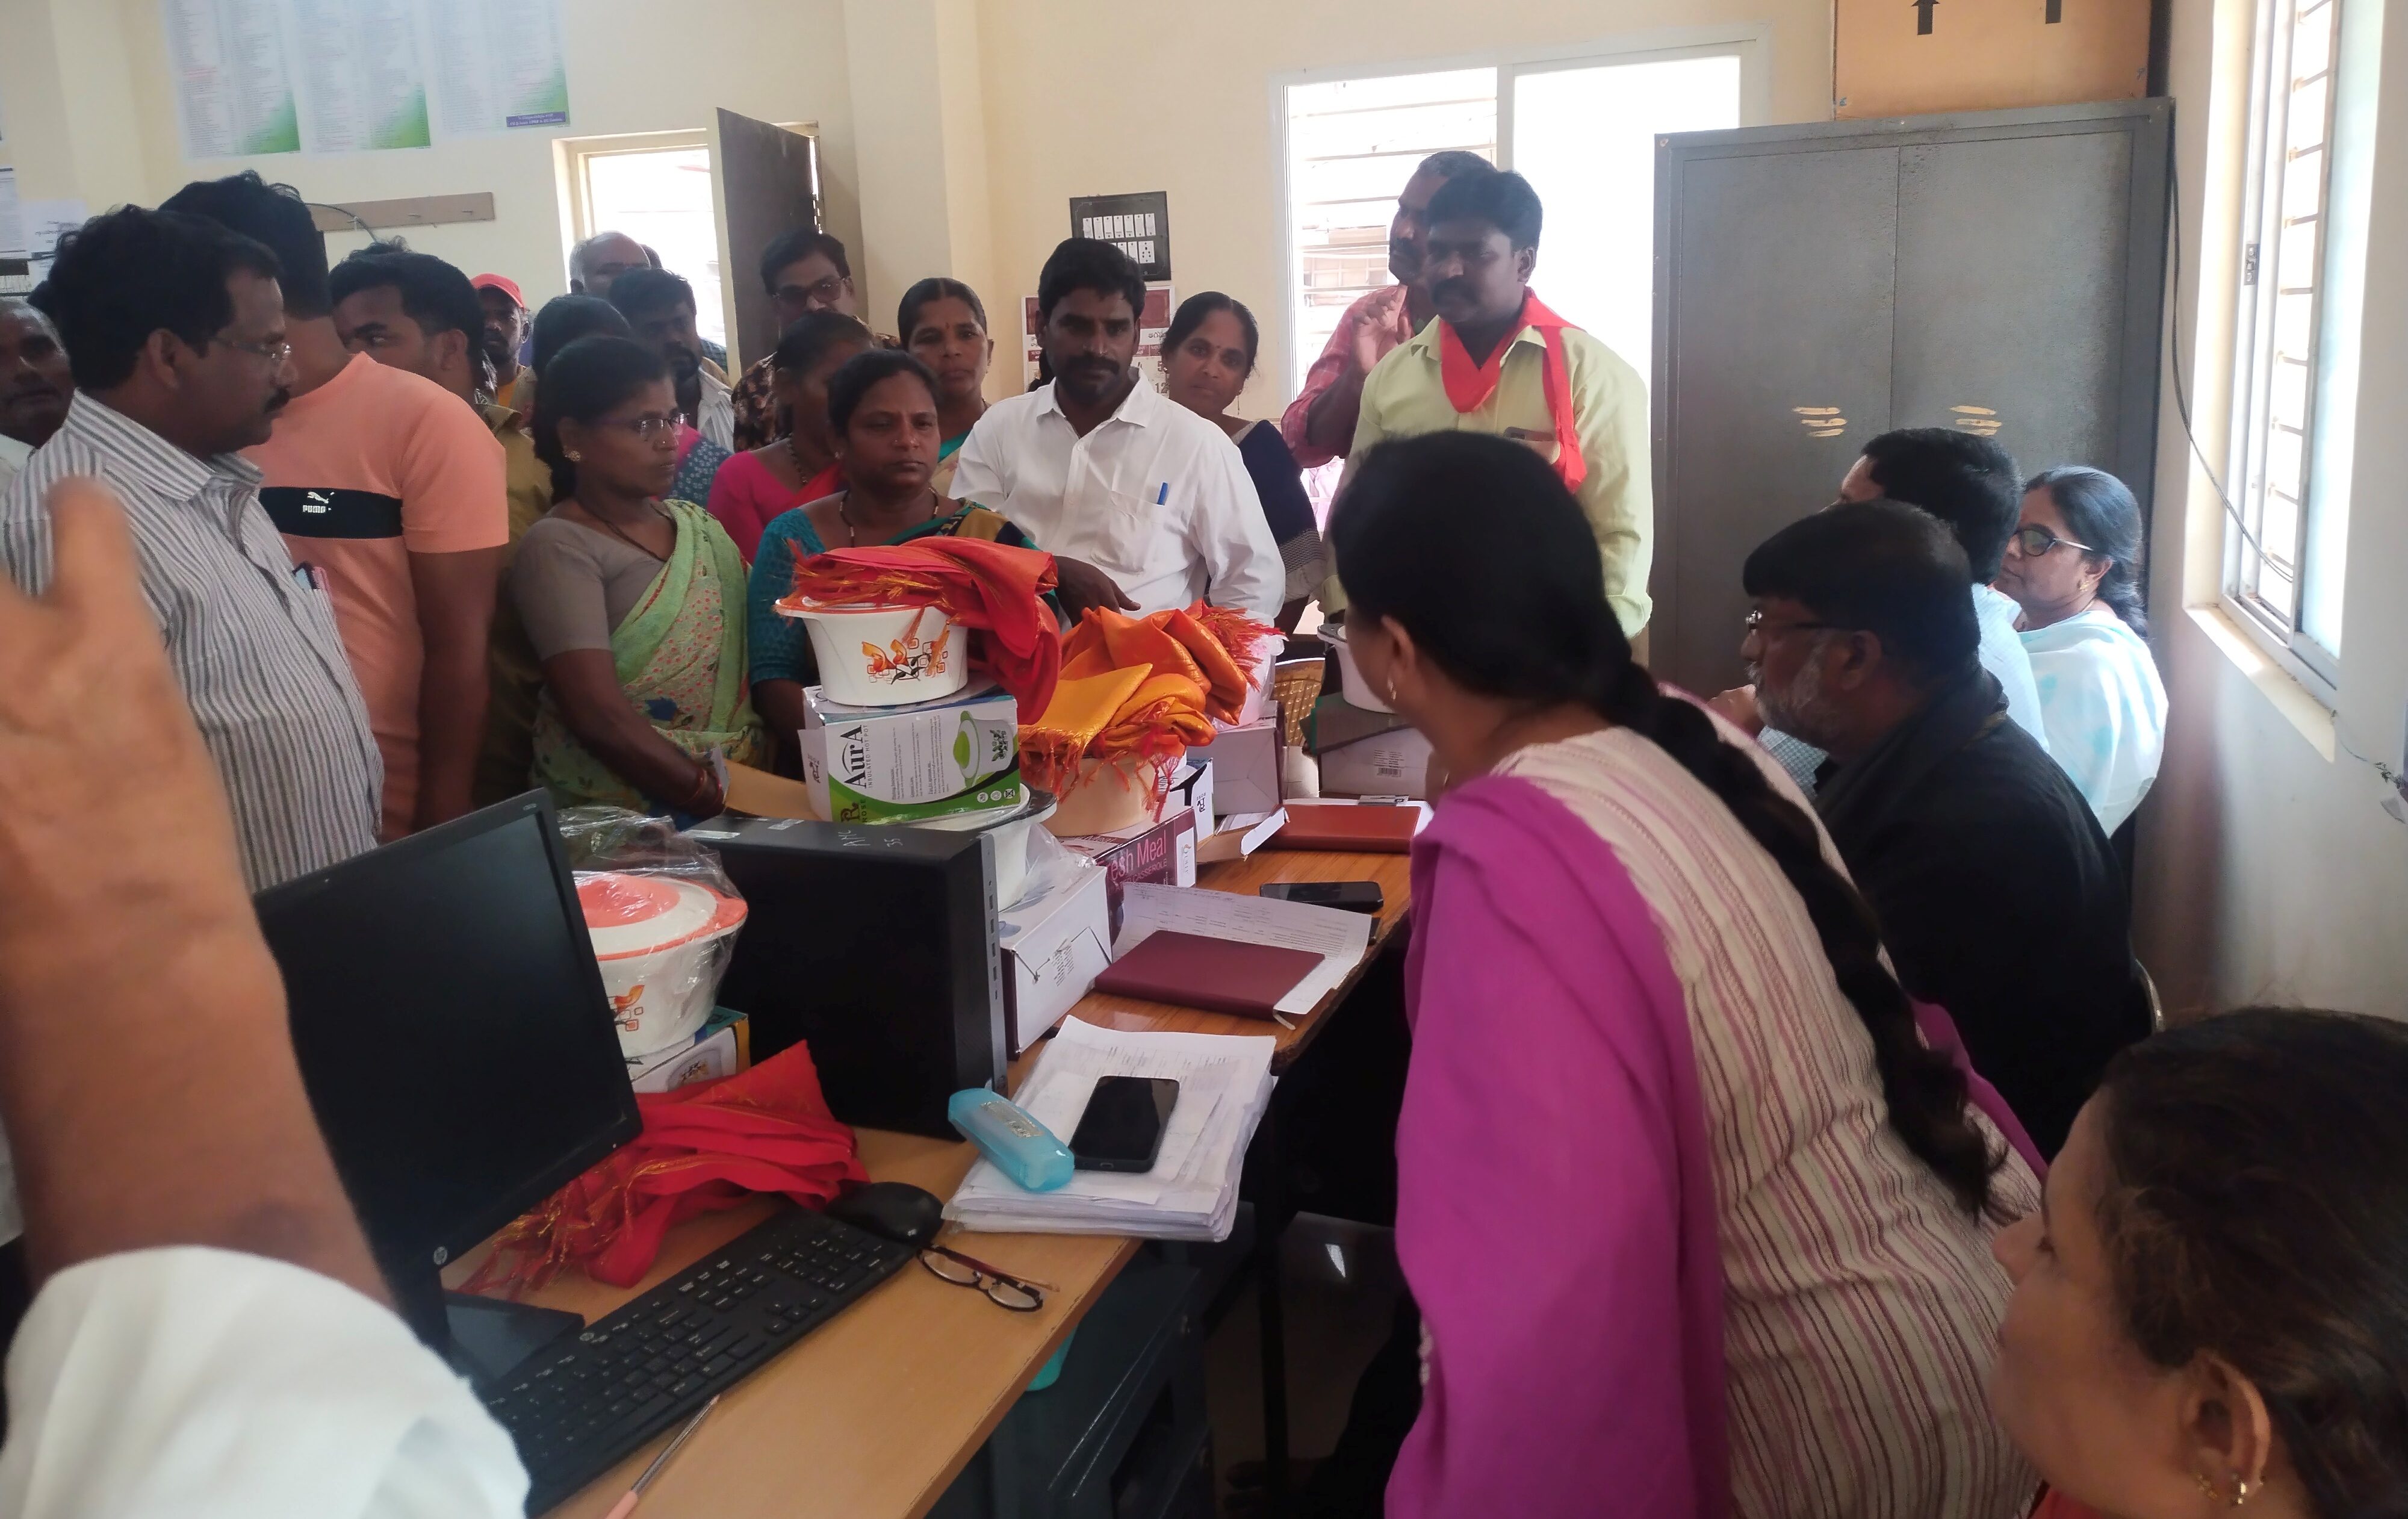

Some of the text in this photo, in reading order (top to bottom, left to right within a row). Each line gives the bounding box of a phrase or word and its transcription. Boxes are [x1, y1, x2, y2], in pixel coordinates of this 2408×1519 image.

[303, 505, 326, 514] PUMA
[1137, 830, 1167, 868] Meal
[1132, 858, 1168, 883] CASSEROLE
